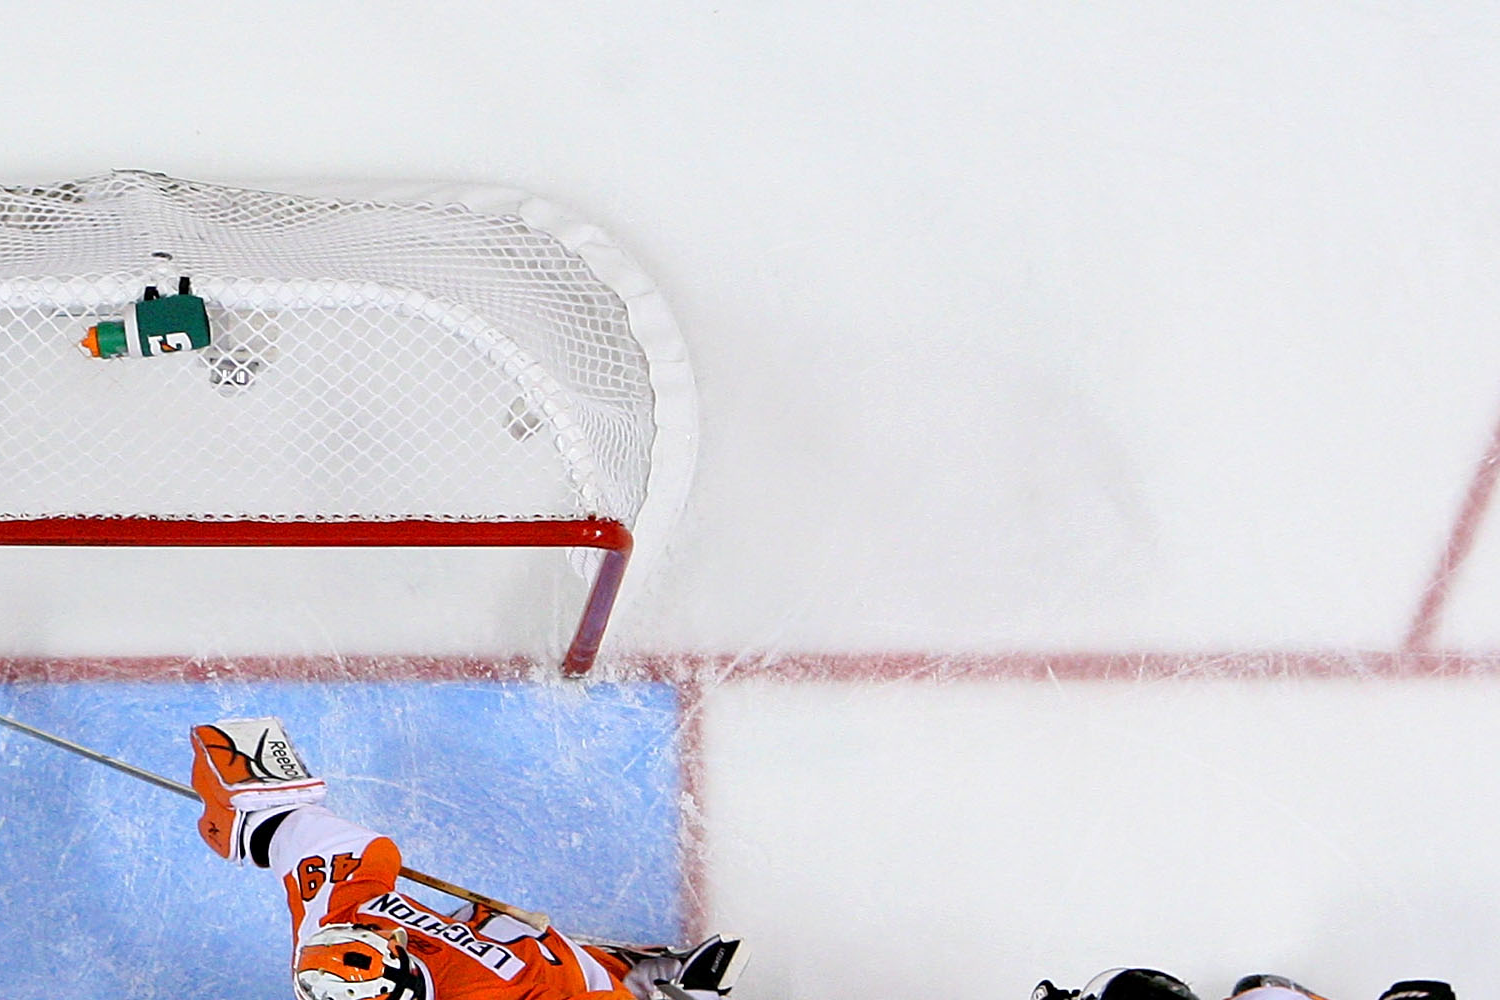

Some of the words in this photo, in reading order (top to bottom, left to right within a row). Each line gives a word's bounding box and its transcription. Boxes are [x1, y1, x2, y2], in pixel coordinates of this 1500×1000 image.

[267, 740, 299, 779] Reebo
[297, 852, 362, 902] 49
[368, 892, 514, 970] LEIGHTON
